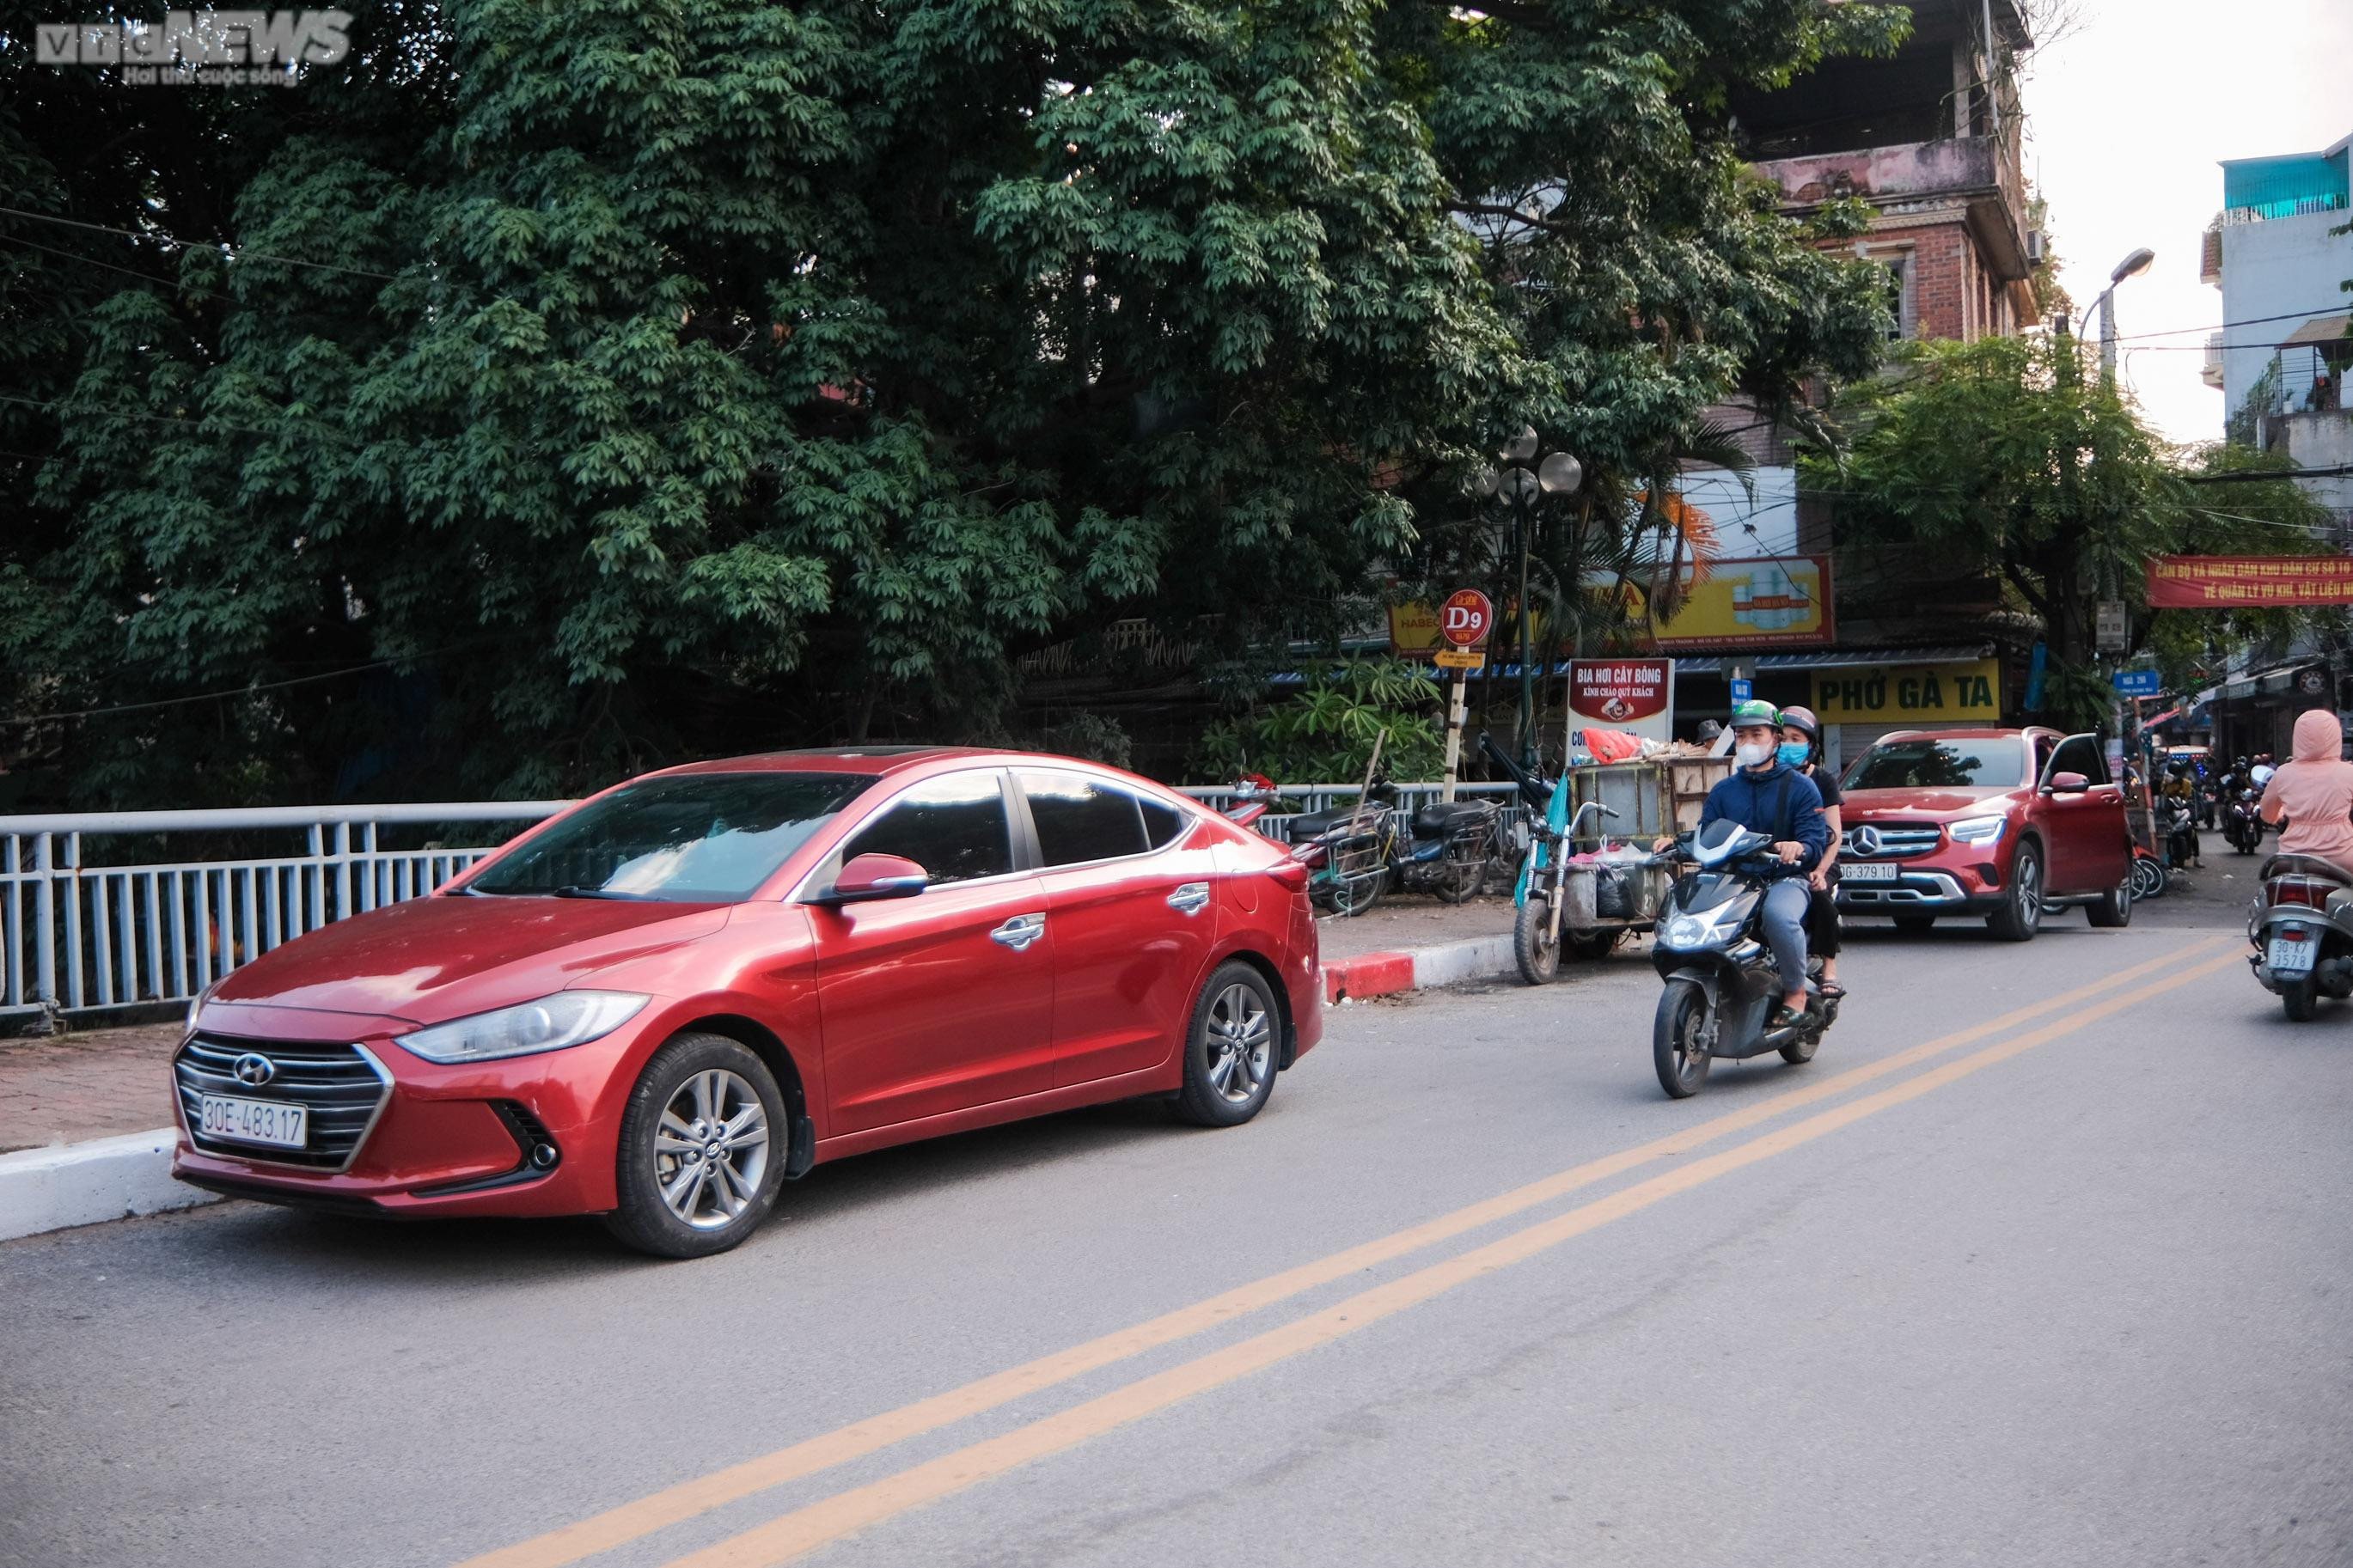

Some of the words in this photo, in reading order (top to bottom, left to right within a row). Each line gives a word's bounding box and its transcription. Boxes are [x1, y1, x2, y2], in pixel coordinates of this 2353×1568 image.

[2260, 563, 2280, 576] KHU
[2283, 561, 2303, 576] DÂN
[2338, 562, 2350, 574] 10
[2298, 580, 2317, 600] VẬT
[2319, 580, 2341, 599] LIỆU
[1401, 618, 1441, 629] HABEC
[1445, 607, 1482, 629] D9
[1577, 668, 1593, 683] BIA
[1595, 667, 1611, 683] HƠI
[1614, 665, 1632, 684] CÂY
[1635, 665, 1661, 683] BÔNG
[1583, 685, 1598, 696] KÍNH
[1600, 685, 1617, 696] CHÀO
[1617, 685, 1631, 699] QUÝ
[1632, 685, 1654, 697] KHÁCH
[1819, 668, 1887, 711] PHỞ
[1898, 670, 1944, 710] GÀ
[1954, 675, 1993, 707] TA
[1840, 865, 1894, 878] 0G-379.10
[2275, 954, 2306, 967] 3578
